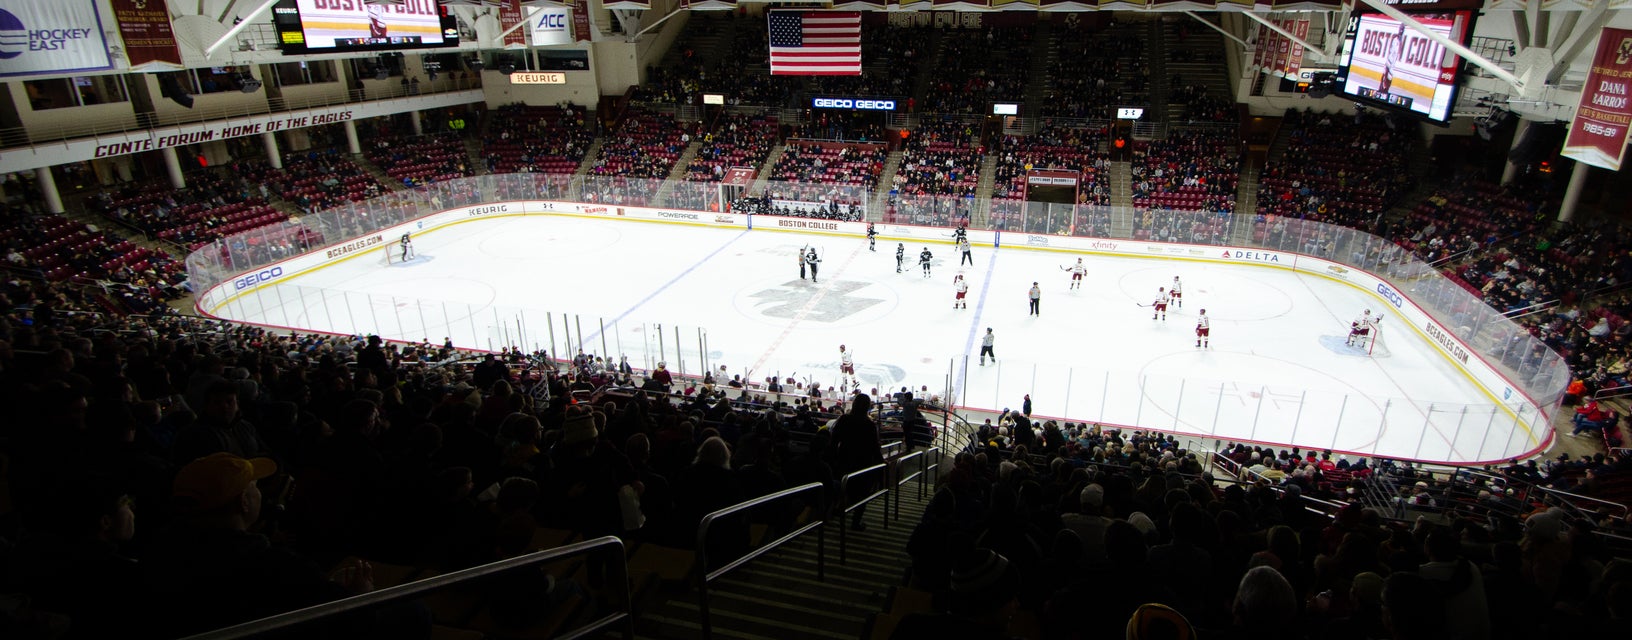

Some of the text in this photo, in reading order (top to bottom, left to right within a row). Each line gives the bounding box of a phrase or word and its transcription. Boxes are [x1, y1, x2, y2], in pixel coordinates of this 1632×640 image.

[537, 14, 565, 28] ACC
[29, 28, 91, 41] HOCKEY
[29, 40, 66, 51] EAST
[517, 74, 558, 83] KEURIG
[1600, 81, 1625, 95] DANA
[814, 98, 895, 110] GEICO GEICO
[1592, 93, 1628, 109] BARROS
[94, 111, 352, 158] CONTE FORUM HOME OF THE EAGLES
[1583, 122, 1617, 138] 1985-89
[468, 205, 508, 216] KEURIG
[657, 211, 699, 220] POWERADE
[778, 219, 838, 231] BOSTON COLLEGE
[327, 234, 383, 259] BCEAGLES.COM
[1091, 240, 1118, 250] xfinity
[1235, 250, 1279, 262] DELTA
[235, 266, 283, 290] GEICO
[1377, 282, 1402, 308] GEICO
[1426, 322, 1469, 364] BCEAGLES.COM
